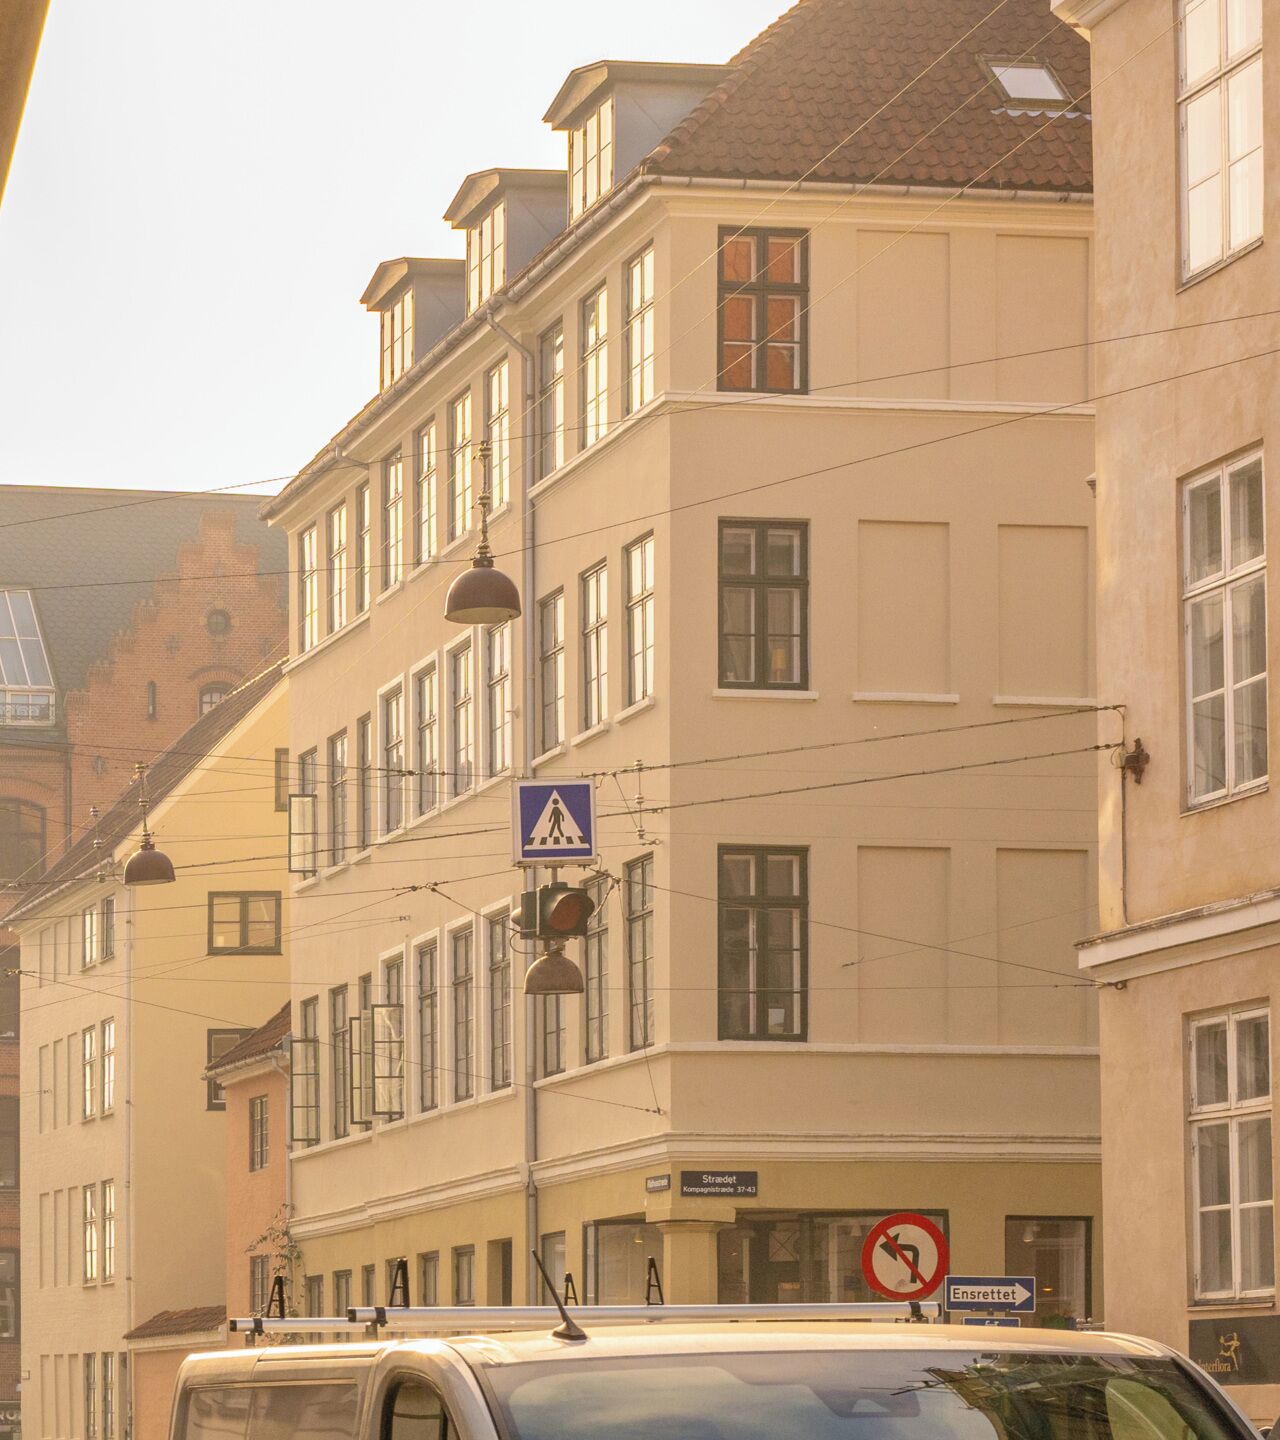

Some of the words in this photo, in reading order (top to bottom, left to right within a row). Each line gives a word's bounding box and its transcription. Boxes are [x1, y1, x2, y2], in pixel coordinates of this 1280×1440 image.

[702, 1174, 737, 1185] Strædet
[683, 1185, 734, 1194] Kompagnistræde
[952, 1287, 1017, 1301] Ensrettet
